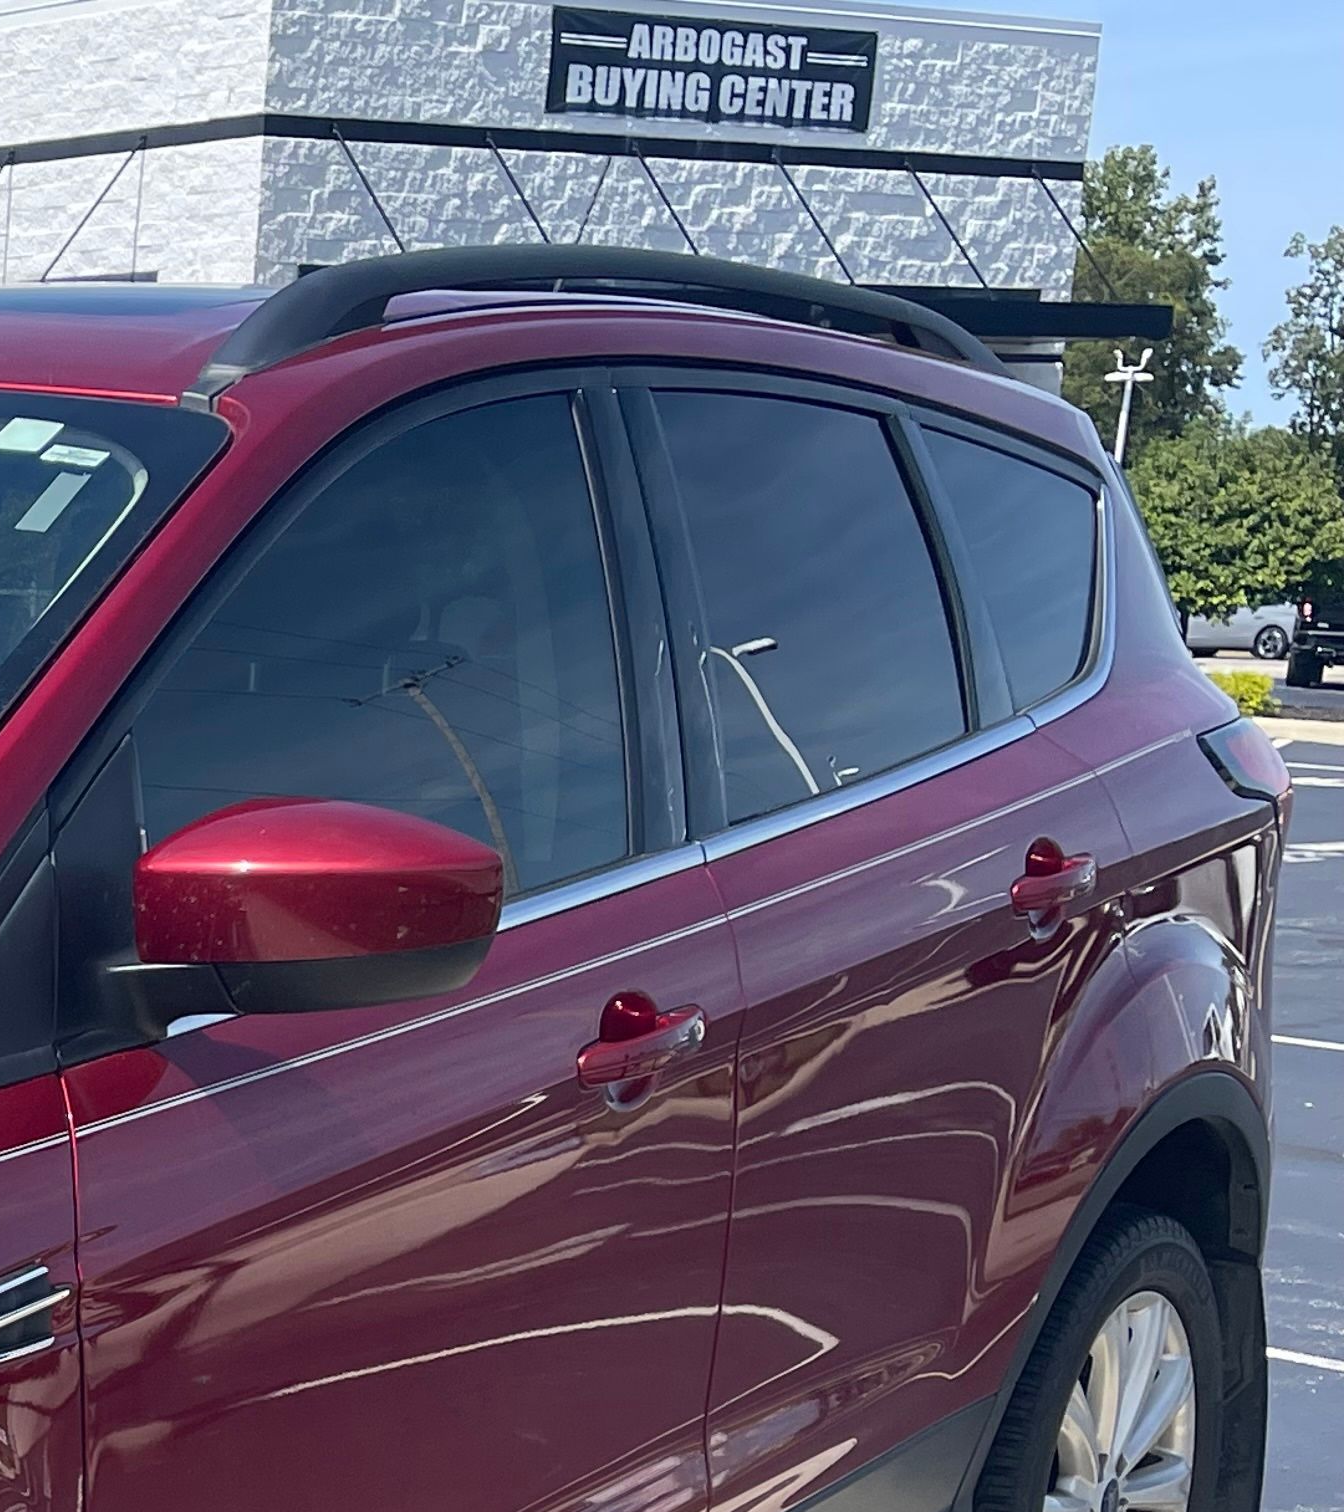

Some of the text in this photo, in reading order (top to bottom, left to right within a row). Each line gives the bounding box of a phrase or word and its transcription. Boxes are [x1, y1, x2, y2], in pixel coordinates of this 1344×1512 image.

[627, 23, 808, 70] ARBOGAST
[566, 63, 855, 121] BUYING CENTER
